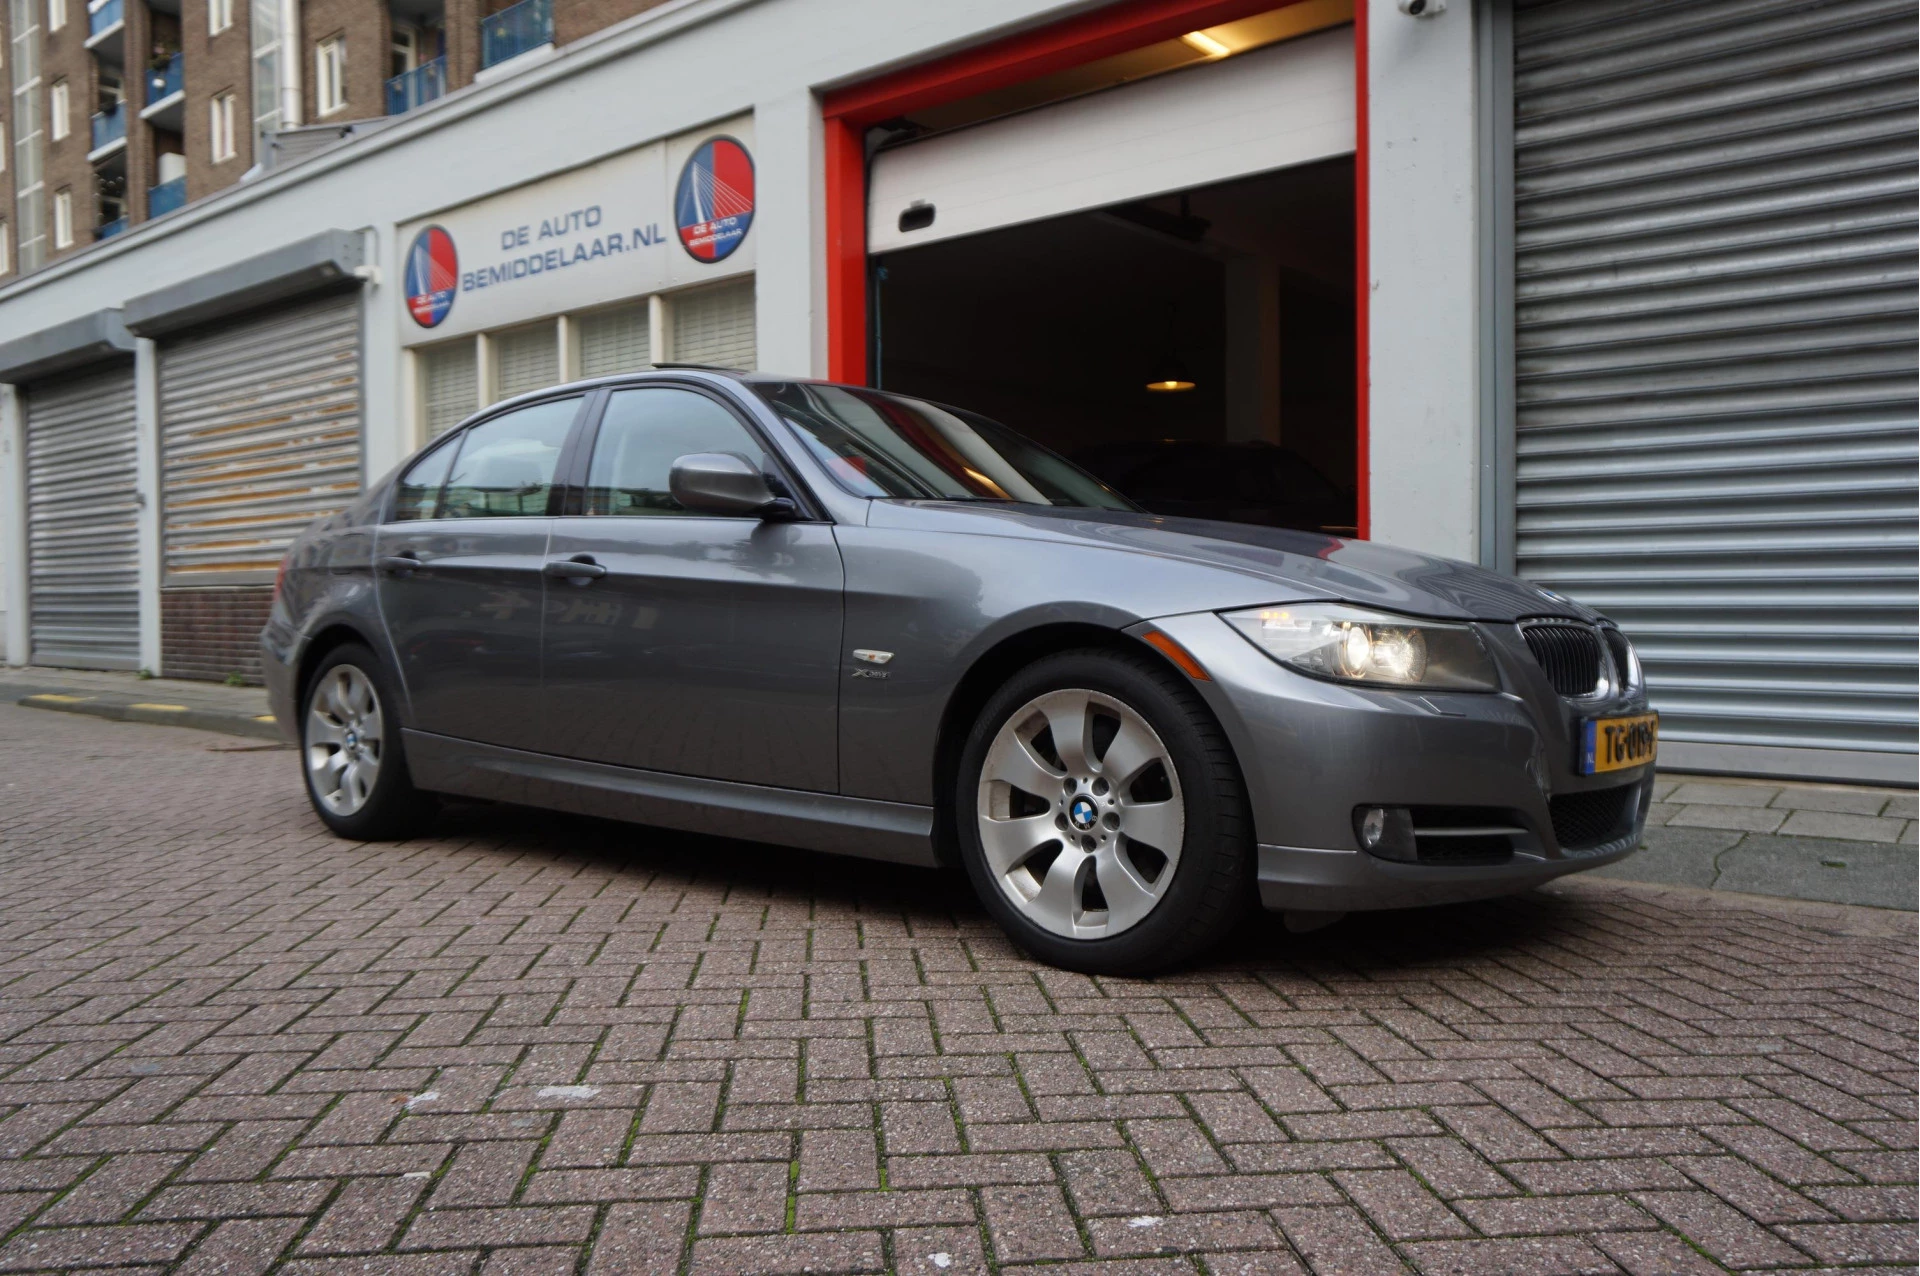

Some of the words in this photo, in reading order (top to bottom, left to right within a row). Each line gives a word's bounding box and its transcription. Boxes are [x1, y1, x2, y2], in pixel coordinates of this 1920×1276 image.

[502, 225, 530, 251] DE
[537, 204, 602, 241] AUTO
[693, 223, 708, 235] DE
[709, 216, 737, 231] AUTO
[462, 222, 667, 292] BEMIDDELAAR.NL
